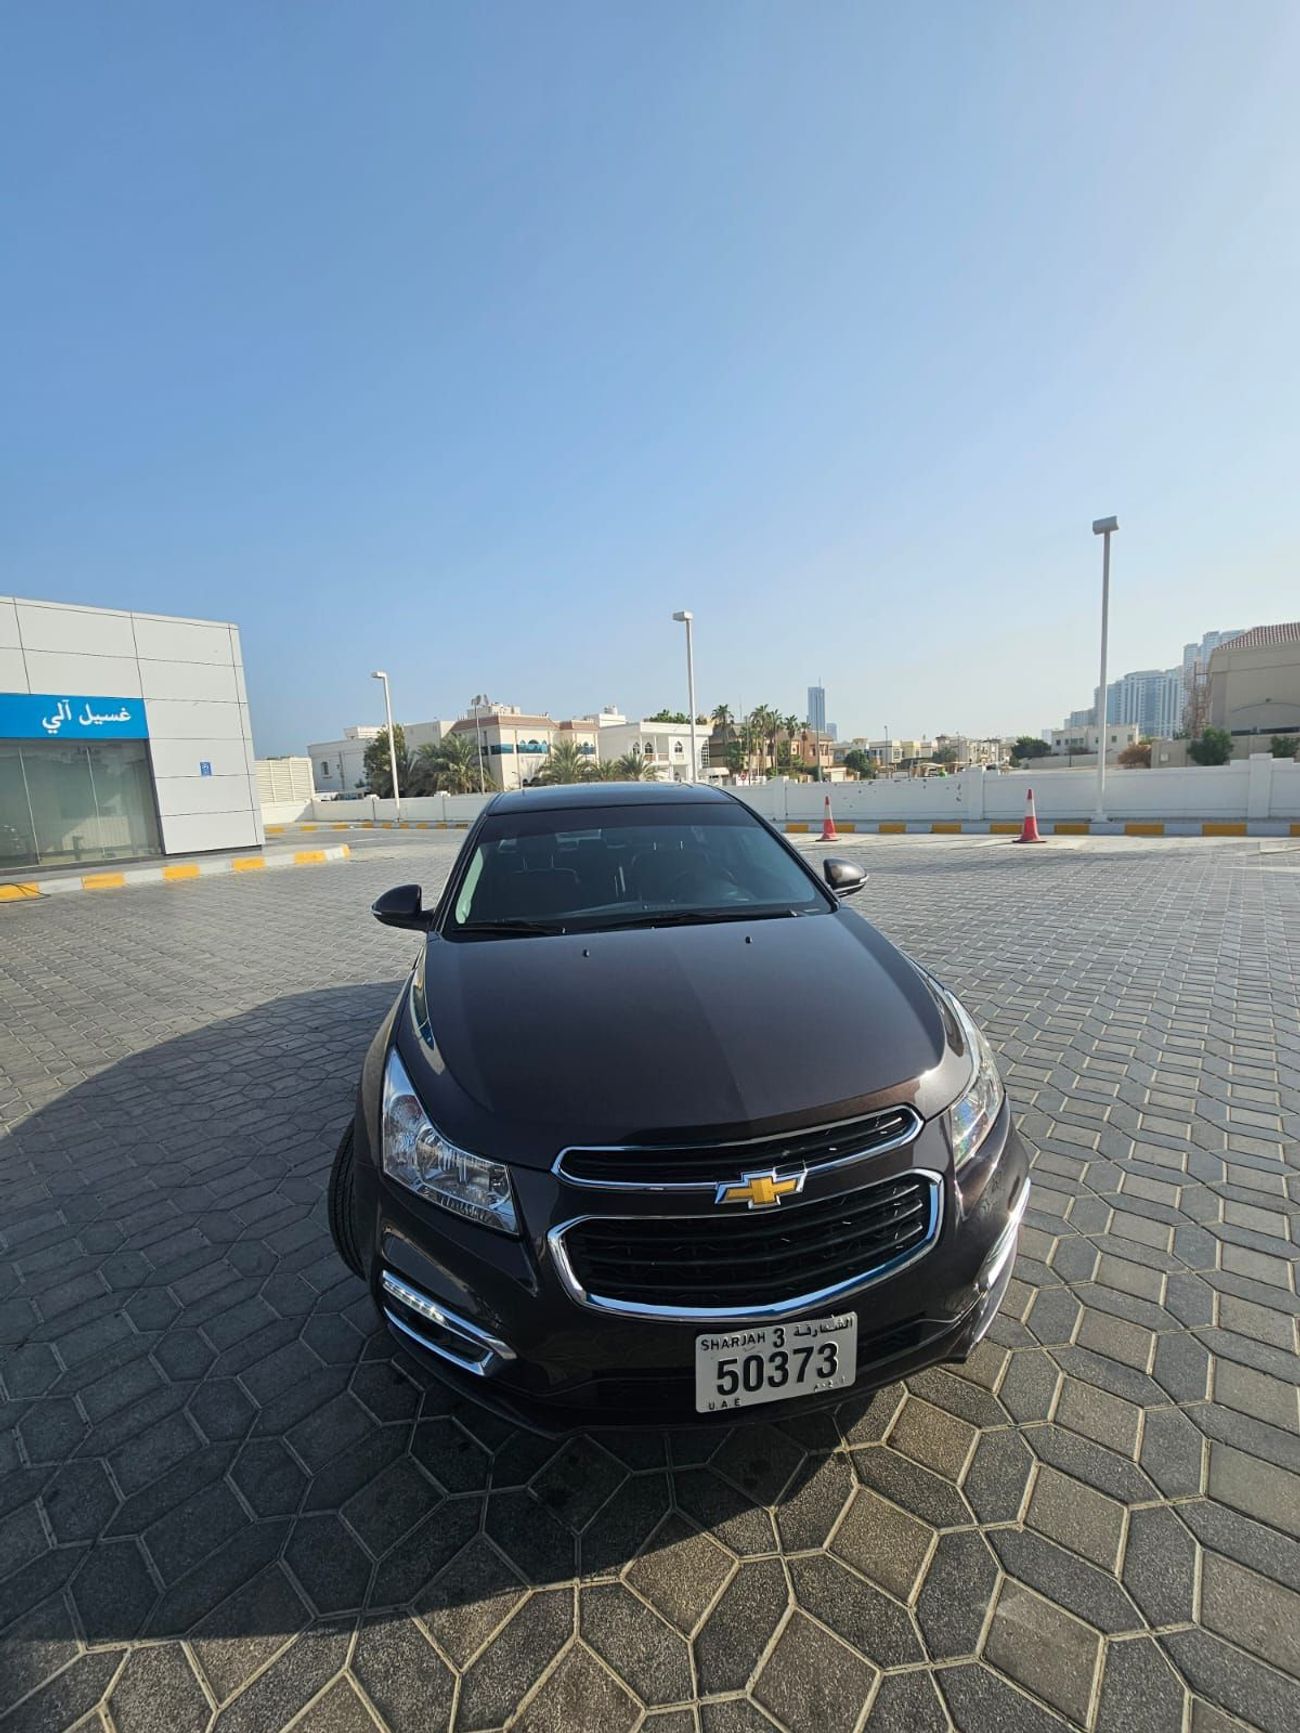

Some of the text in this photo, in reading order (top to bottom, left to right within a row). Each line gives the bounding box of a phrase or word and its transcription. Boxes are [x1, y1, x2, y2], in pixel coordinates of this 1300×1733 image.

[42, 699, 131, 734] غسيل آلي
[701, 1327, 785, 1351] SHARJAH 3
[716, 1342, 838, 1396] 50373
